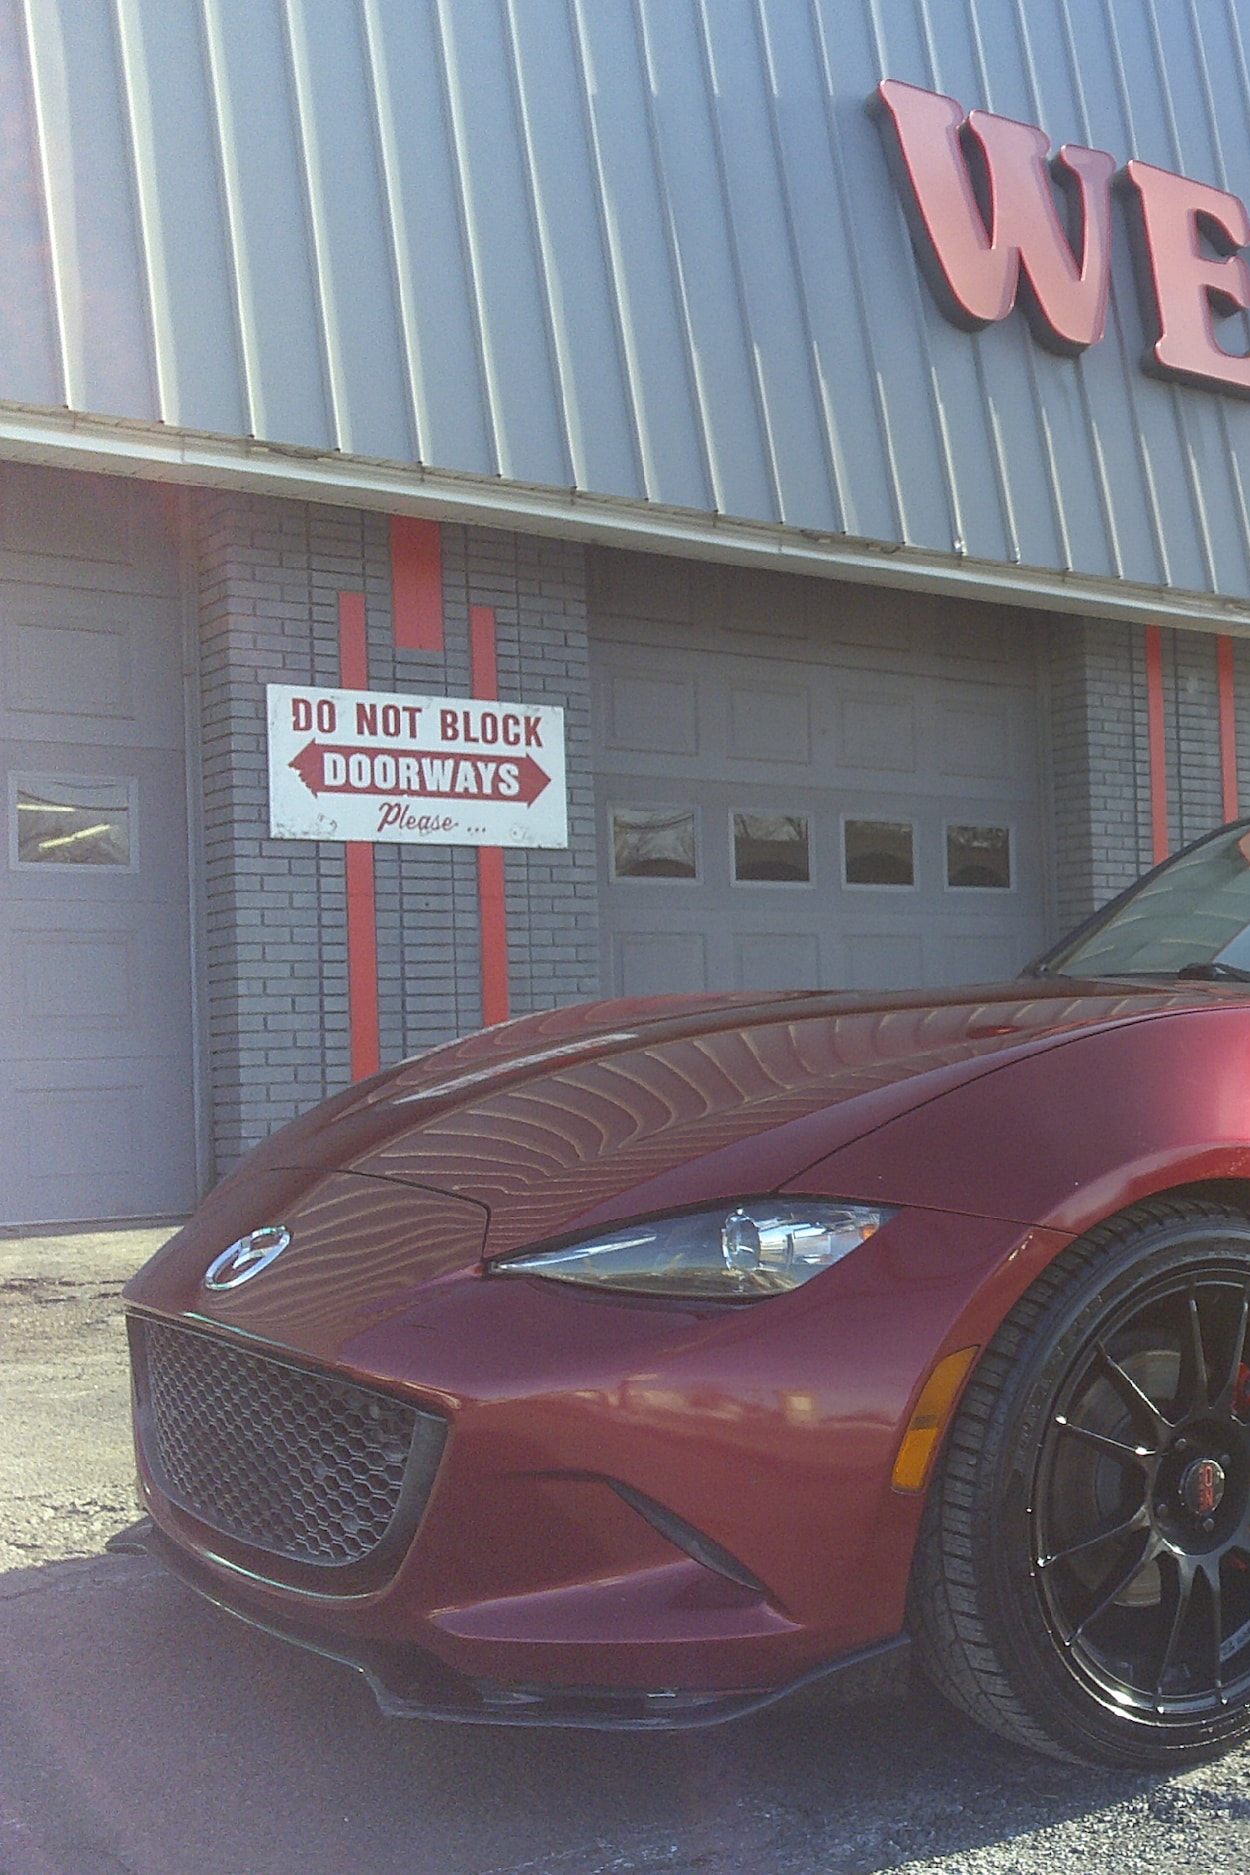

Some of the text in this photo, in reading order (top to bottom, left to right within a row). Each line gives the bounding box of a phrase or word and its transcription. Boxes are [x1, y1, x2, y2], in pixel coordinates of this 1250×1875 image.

[292, 697, 544, 747] DO NOT BLOCK
[322, 752, 520, 797] DOORWAYS
[377, 801, 459, 833] Please
